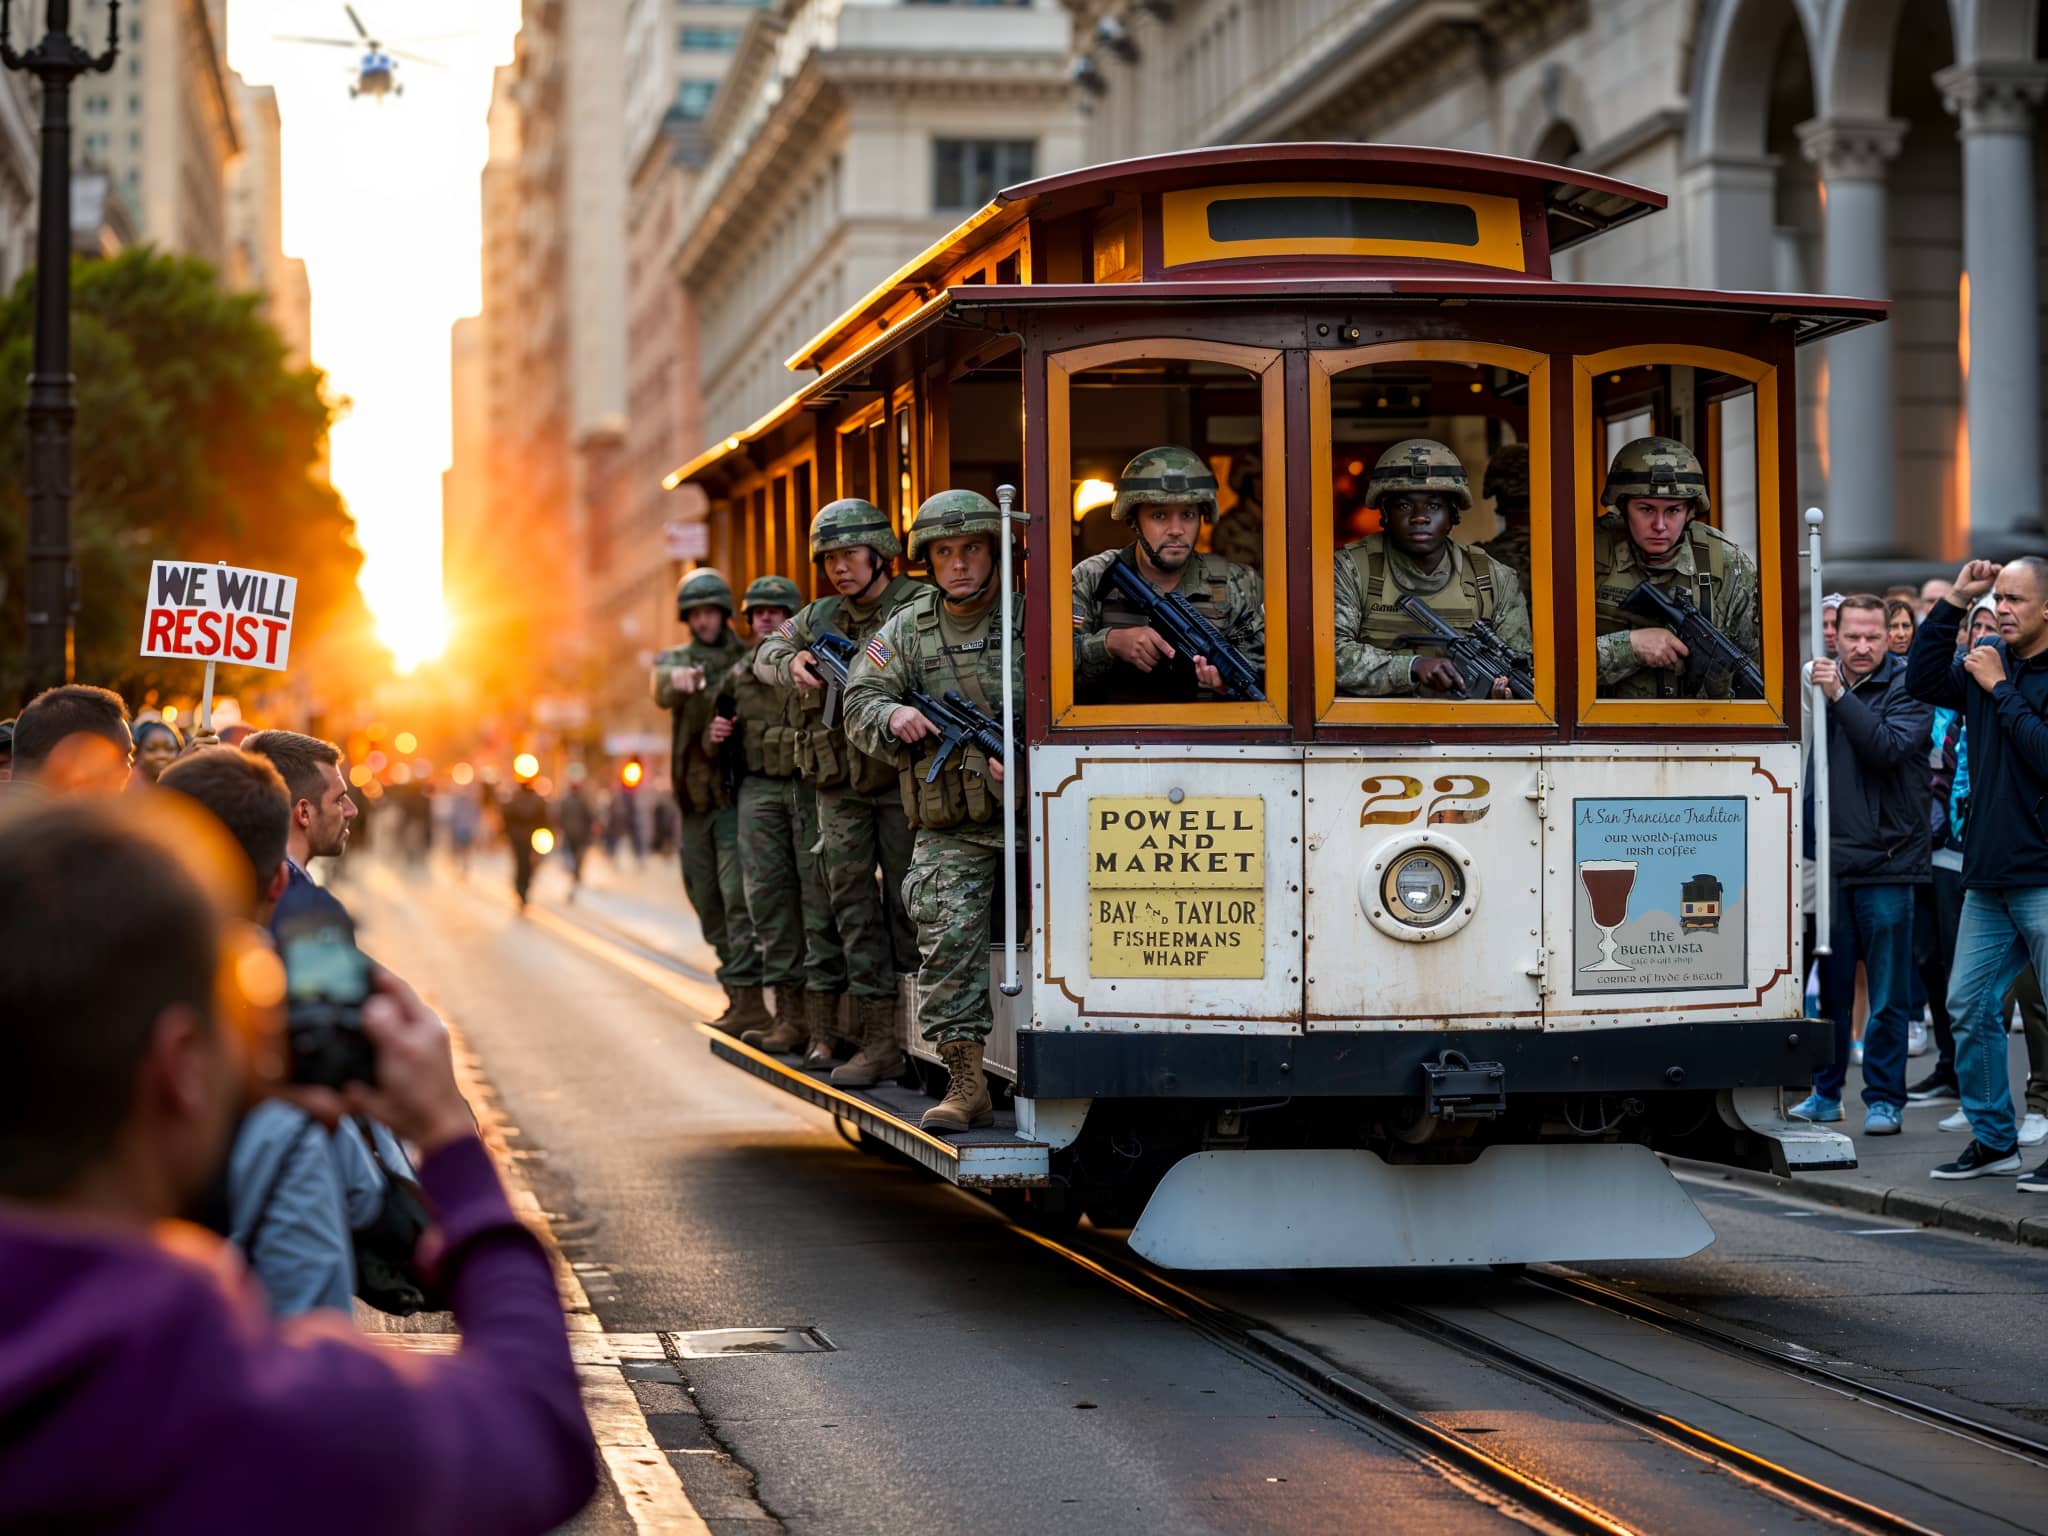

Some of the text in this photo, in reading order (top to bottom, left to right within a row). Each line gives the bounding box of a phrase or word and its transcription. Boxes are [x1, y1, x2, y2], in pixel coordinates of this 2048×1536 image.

[157, 565, 290, 620] WE WILL
[147, 609, 287, 664] RESIST
[1360, 775, 1491, 828] 22
[1100, 810, 1254, 831] POWELL
[1578, 805, 1743, 826] A San Francisco Tradition
[1140, 834, 1215, 850] AND
[1095, 852, 1256, 873] MARKET
[1100, 900, 1257, 925] BAY AND TAYLOR
[1113, 931, 1241, 947] FISHERMANS
[1143, 951, 1209, 966] WHARF
